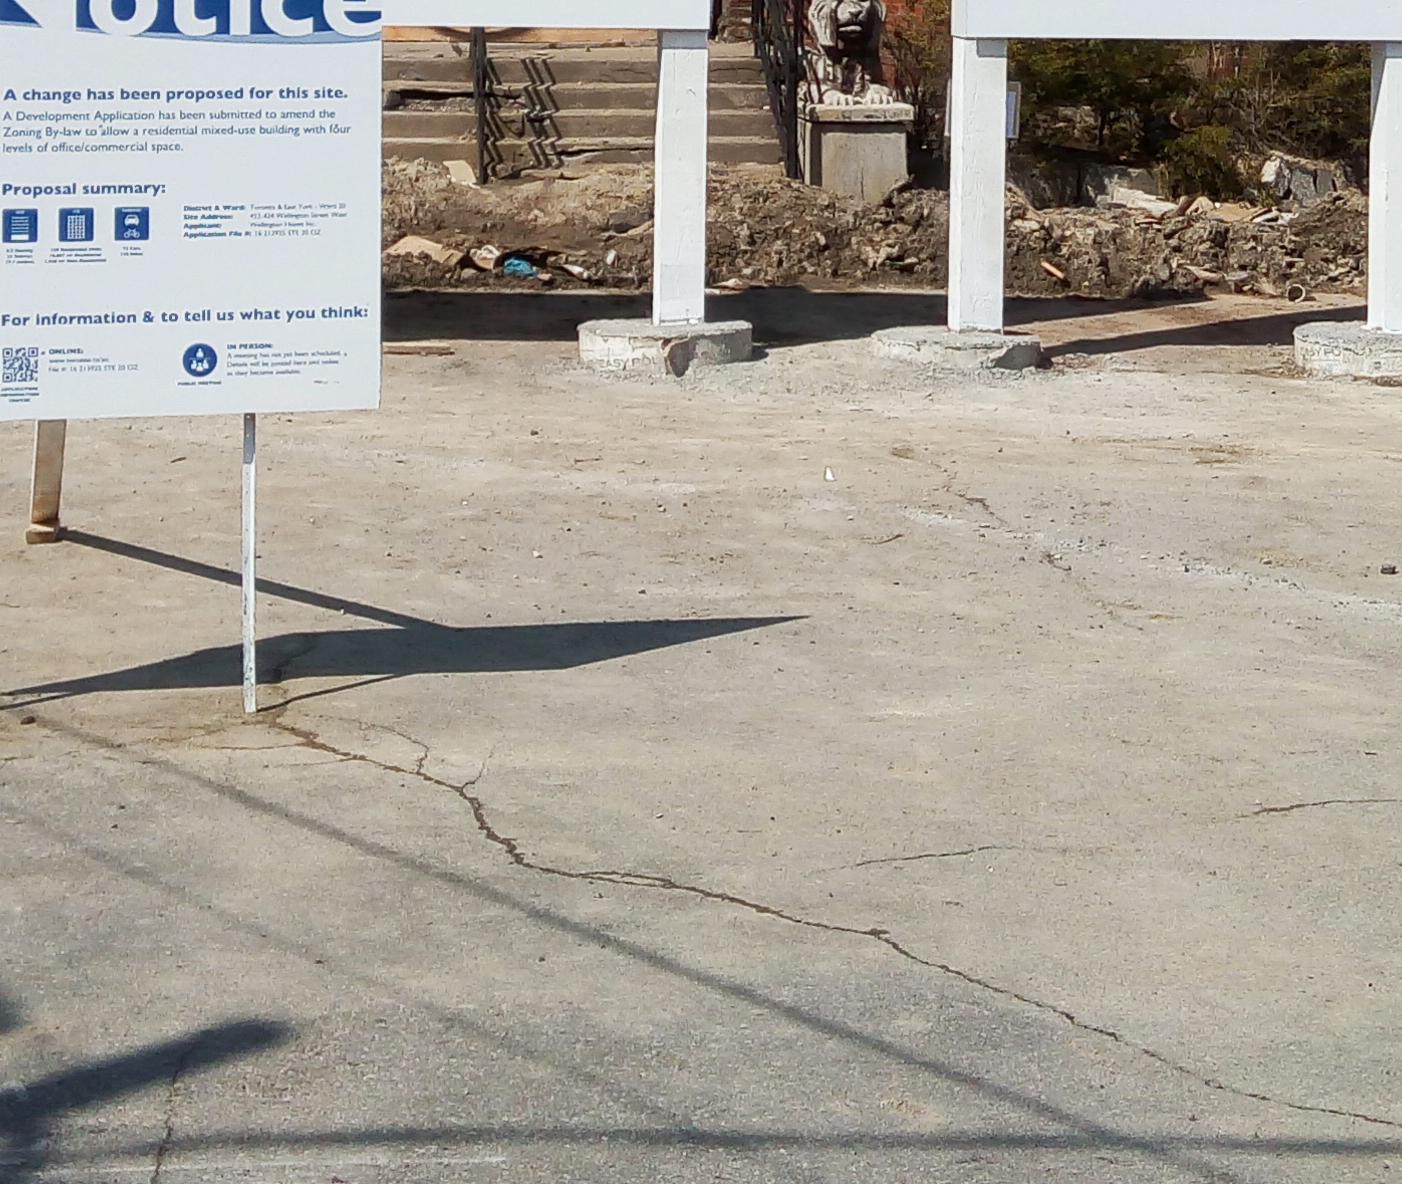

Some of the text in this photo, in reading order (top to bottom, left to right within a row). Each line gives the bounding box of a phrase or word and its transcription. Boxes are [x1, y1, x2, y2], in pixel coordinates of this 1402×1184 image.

[3, 86, 349, 105] A change has been proposed for this site.
[2, 108, 336, 124] A Development Application has been submitted to amend the
[2, 123, 352, 140] Zoning By-law to allow a residential mixed-use building with four
[2, 141, 184, 155] levels of office/commercial space.
[1, 182, 166, 200] Proposal summary:
[1, 305, 369, 327] For information & to tell us what you think:
